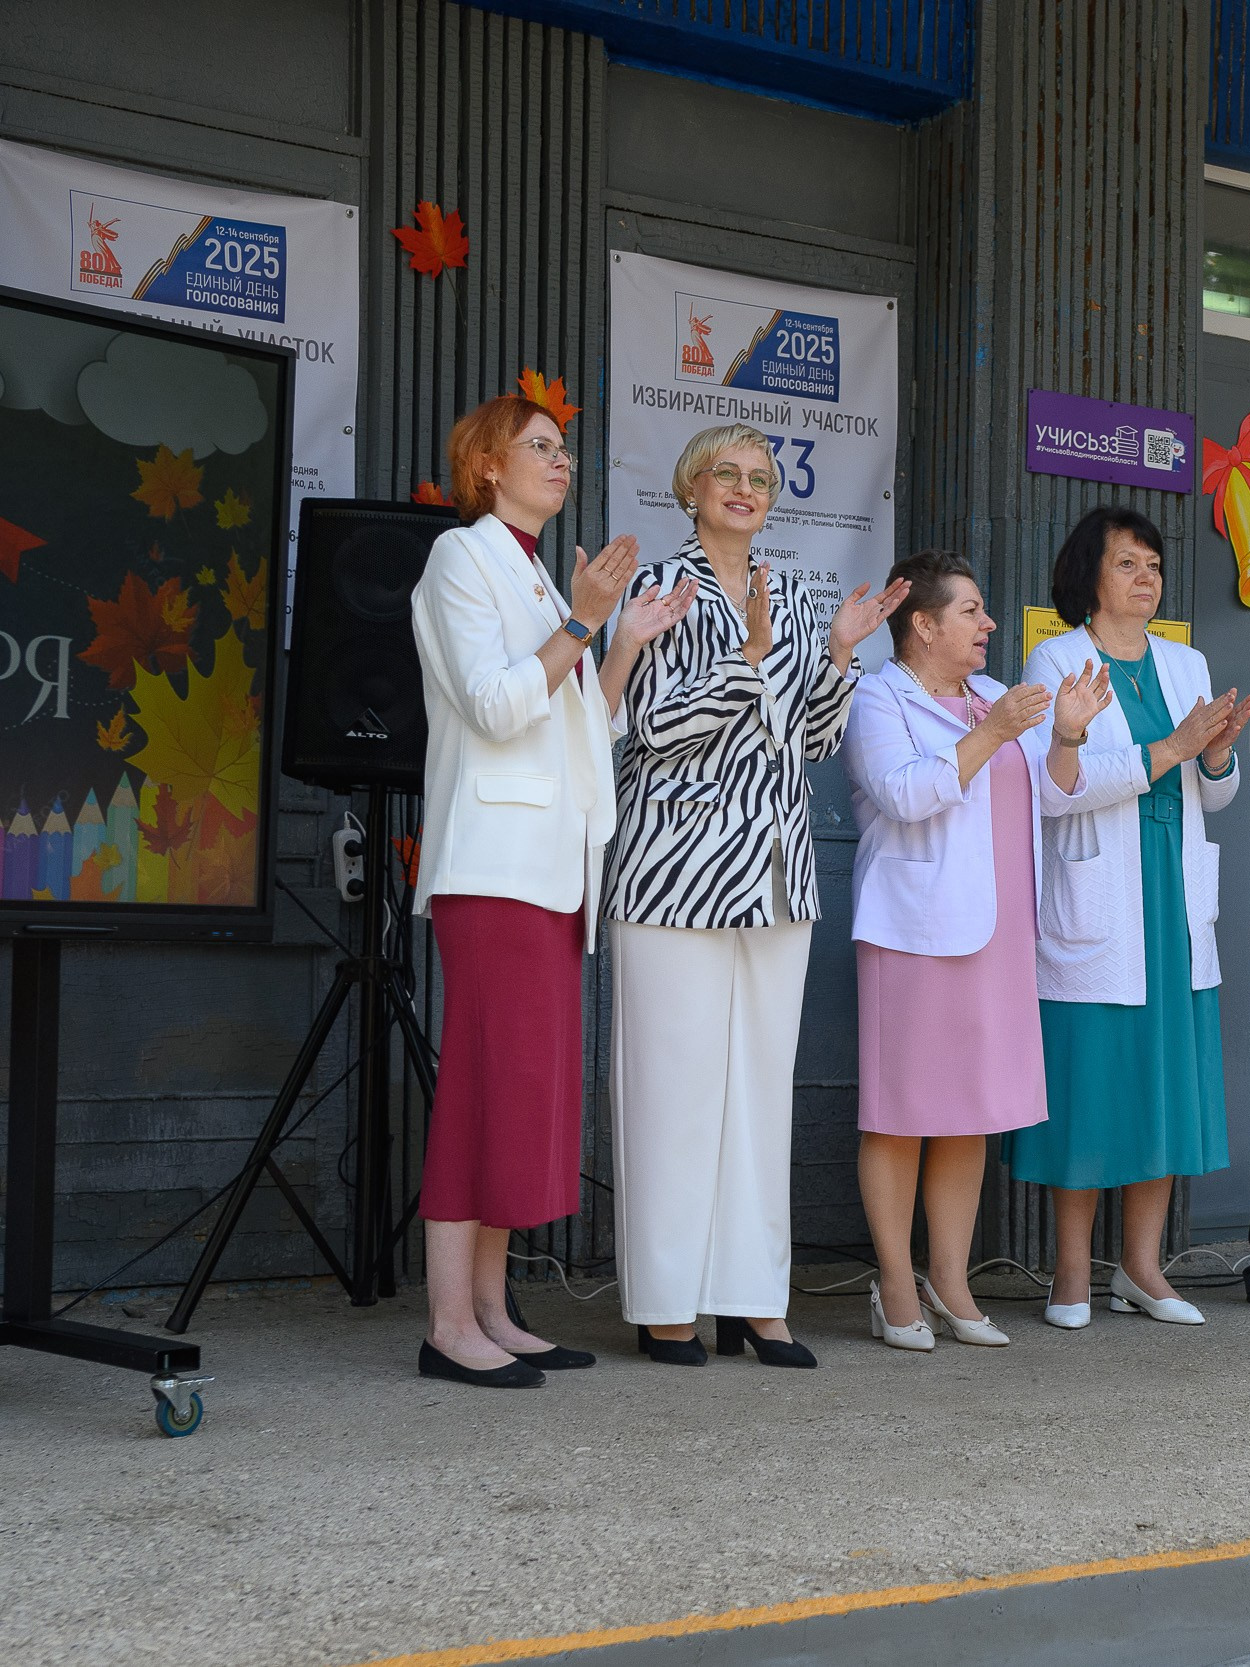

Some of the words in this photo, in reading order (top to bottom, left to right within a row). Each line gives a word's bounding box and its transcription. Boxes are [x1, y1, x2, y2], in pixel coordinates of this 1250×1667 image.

[216, 225, 237, 238] 12-14
[239, 231, 279, 244] сентября
[80, 250, 103, 271] 80
[204, 238, 280, 279] 2025
[79, 272, 123, 289] ПОБЕДА!
[186, 271, 242, 293] ЕДИНЫЙ
[245, 281, 279, 299] ДЕНЬ
[186, 288, 279, 315] голосования
[785, 318, 802, 329] 12-14
[802, 323, 834, 334] сентября
[682, 344, 700, 363] 80
[776, 329, 835, 364] 2025
[681, 364, 715, 377] ПОБЕДА!
[762, 360, 806, 378] ЕДИНЫЙ
[808, 366, 835, 382] ДЕНЬ
[762, 375, 835, 395] голосования
[632, 384, 792, 426] ИЗБИРАТЕЛЬНЫЙ
[802, 408, 879, 437] УЧАСТОК
[1035, 424, 1119, 455] УЧИСЬ33
[292, 465, 319, 476] едняя
[636, 488, 657, 499] Центр:
[639, 498, 675, 510] Владимира
[764, 548, 799, 561] ВХОДЯТ:
[809, 570, 824, 583] 24,
[826, 571, 840, 585] 26,
[346, 730, 388, 739] ALTO
